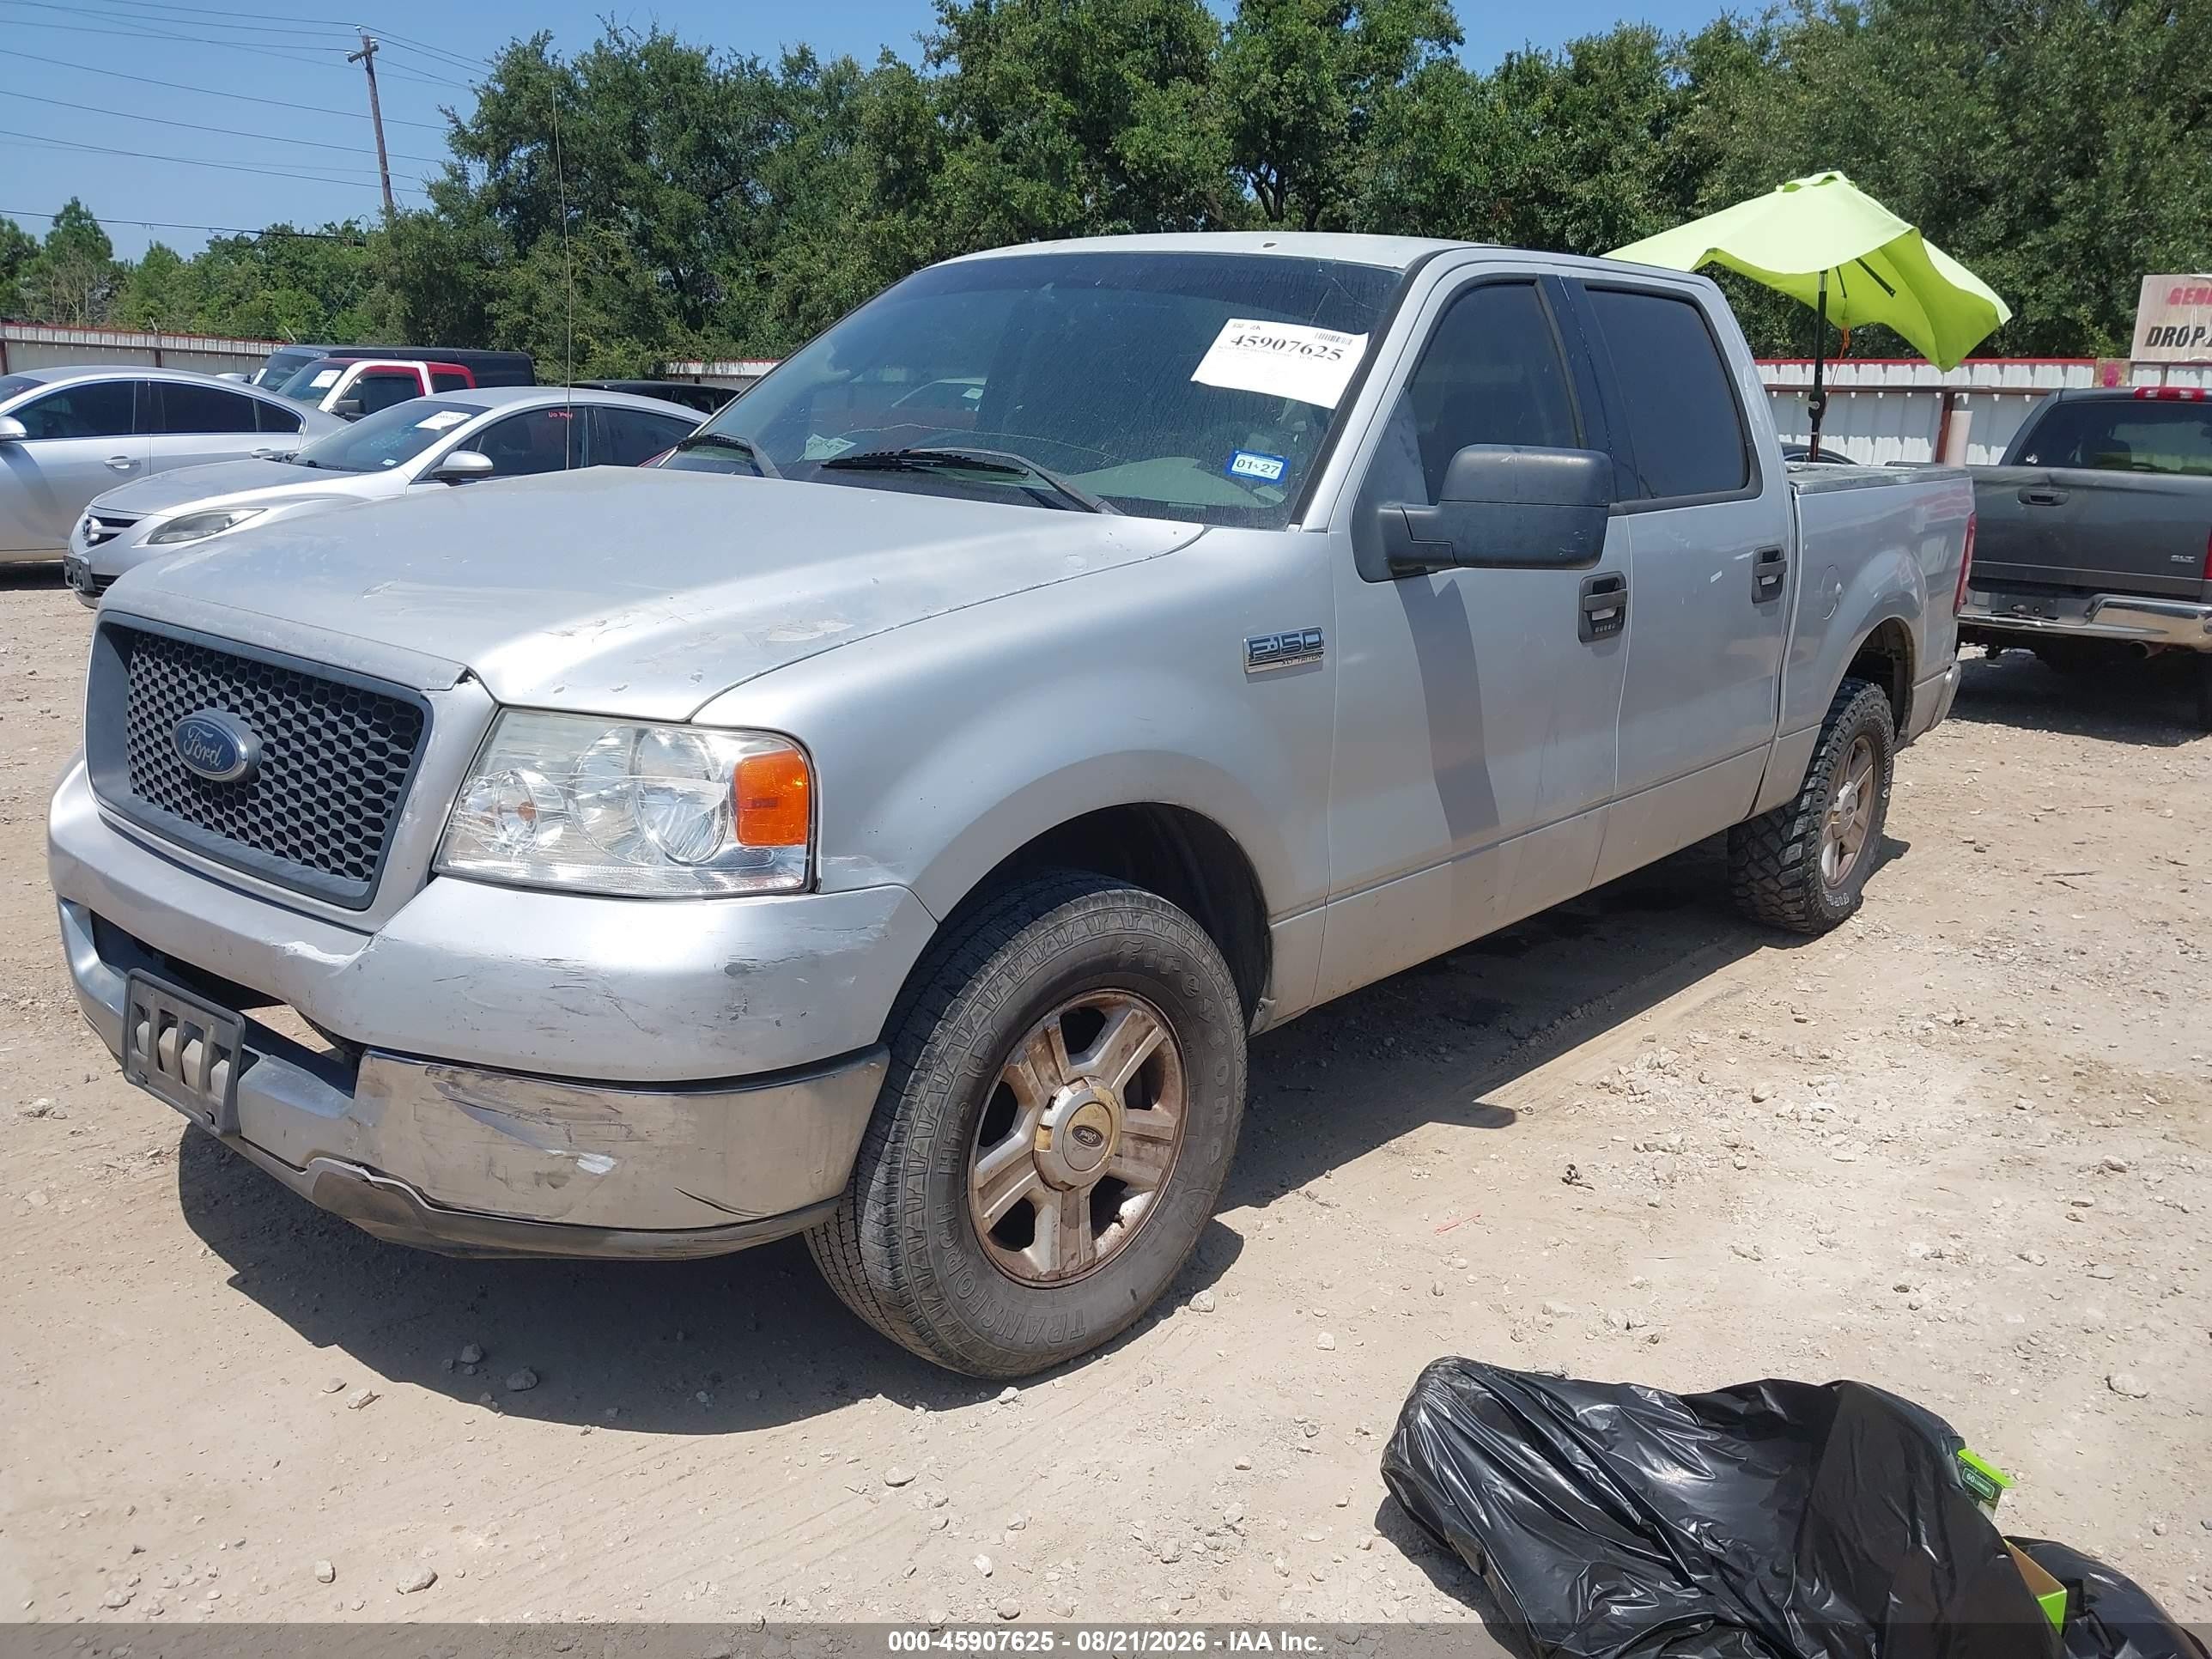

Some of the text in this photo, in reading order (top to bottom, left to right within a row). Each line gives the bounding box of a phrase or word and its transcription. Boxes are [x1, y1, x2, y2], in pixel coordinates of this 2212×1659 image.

[1230, 334, 1345, 362] 45907625
[1237, 459, 1279, 475] 01 27
[183, 725, 223, 766] Ford
[1117, 939, 1230, 1166] Firestone
[935, 1201, 1086, 1346] TRANSFORCE
